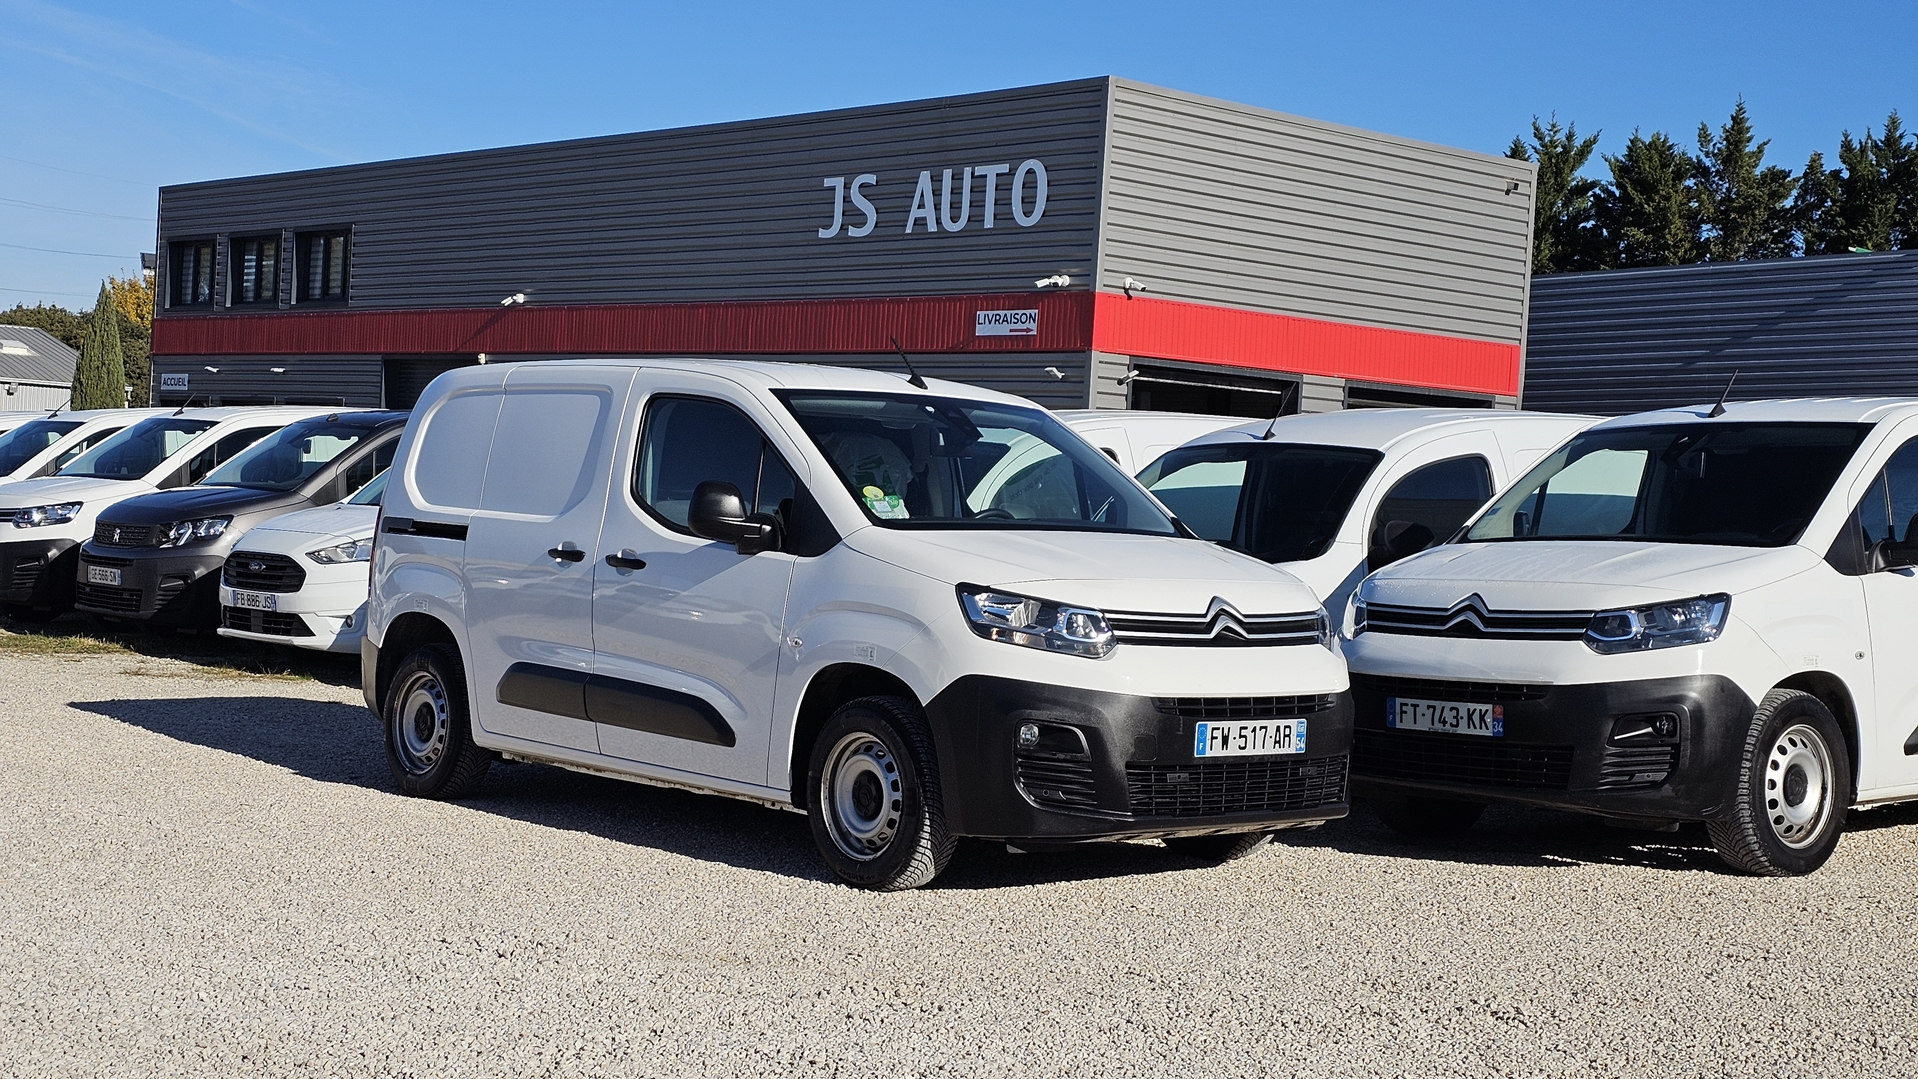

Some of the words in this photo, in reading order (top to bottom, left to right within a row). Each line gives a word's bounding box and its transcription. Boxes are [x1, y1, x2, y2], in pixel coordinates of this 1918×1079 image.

[818, 173, 877, 238] JS
[905, 159, 1048, 233] AUTO
[977, 312, 1036, 325] LIVRAISON
[162, 377, 187, 387] ACCUEIL
[1399, 702, 1489, 731] FT-743-KK
[1493, 721, 1503, 732] 34
[1210, 725, 1292, 751] FW-517-AR
